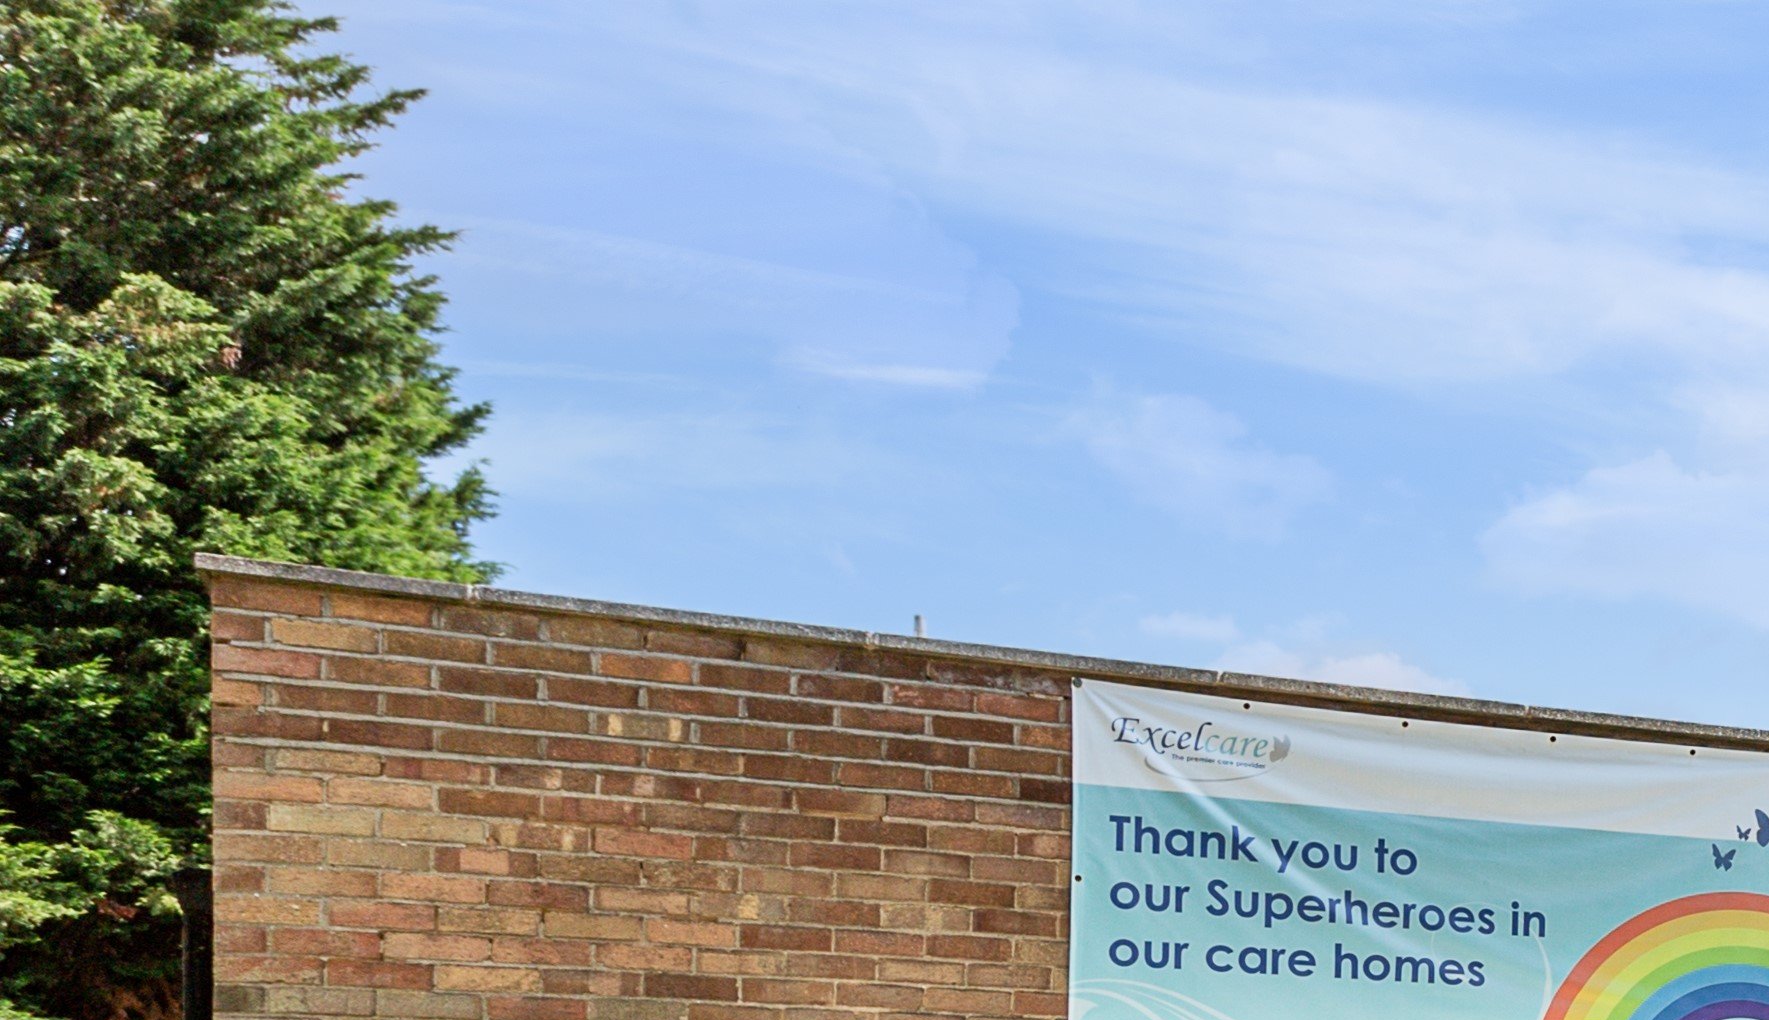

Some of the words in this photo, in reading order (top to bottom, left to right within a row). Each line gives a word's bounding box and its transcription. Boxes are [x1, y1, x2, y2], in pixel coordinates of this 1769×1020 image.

[1111, 717, 1269, 755] Excelcare
[1236, 761, 1266, 769] provider
[1109, 815, 1259, 862] Thank
[1271, 838, 1358, 873] you
[1374, 838, 1418, 875] to
[1109, 881, 1190, 913] our
[1205, 879, 1496, 935] Superheroes
[1511, 901, 1546, 938] in
[1108, 938, 1190, 970] our
[1205, 944, 1317, 977] care
[1334, 943, 1486, 987] homes
